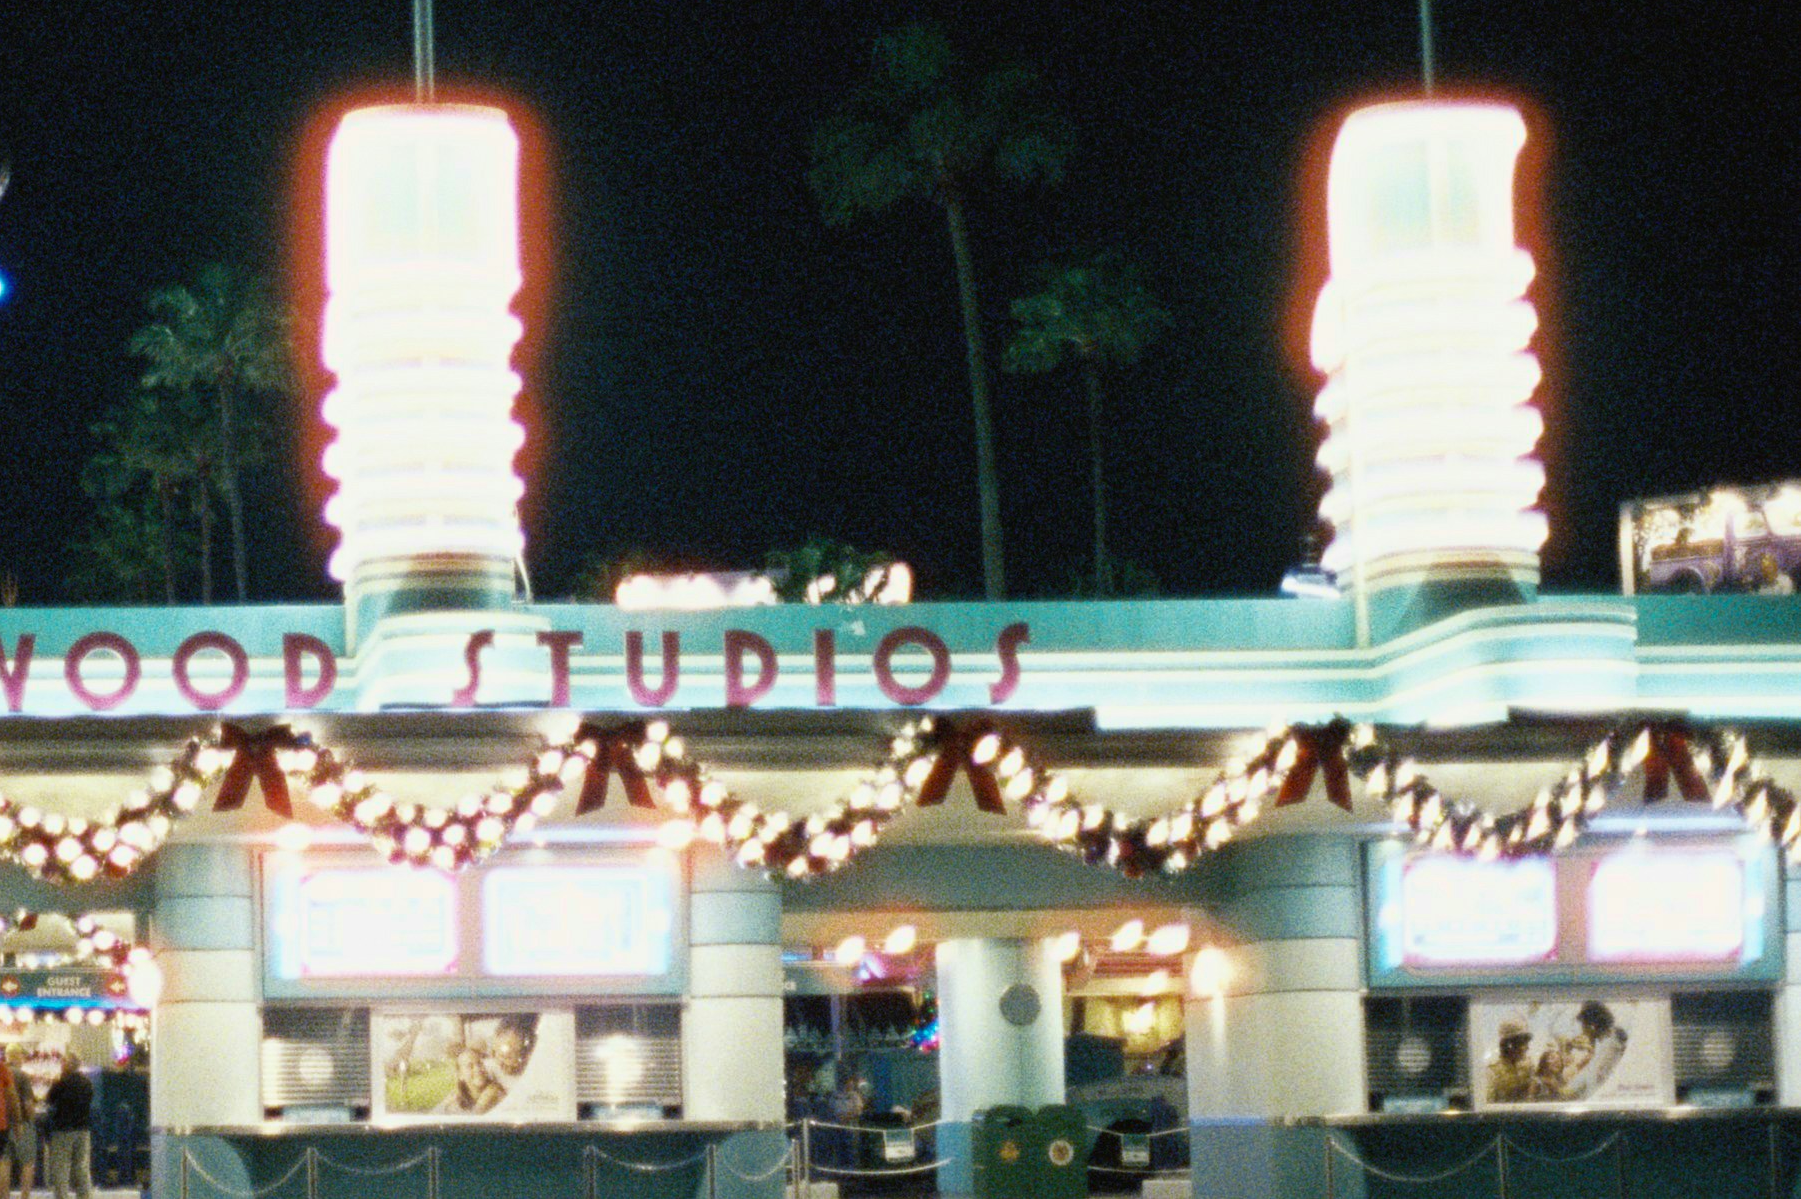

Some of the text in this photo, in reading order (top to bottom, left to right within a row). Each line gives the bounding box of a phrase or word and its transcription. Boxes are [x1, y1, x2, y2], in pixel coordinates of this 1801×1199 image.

[452, 622, 1030, 707] STUDIOS
[47, 977, 81, 987] GUEST
[37, 987, 91, 998] ENTRANCE
